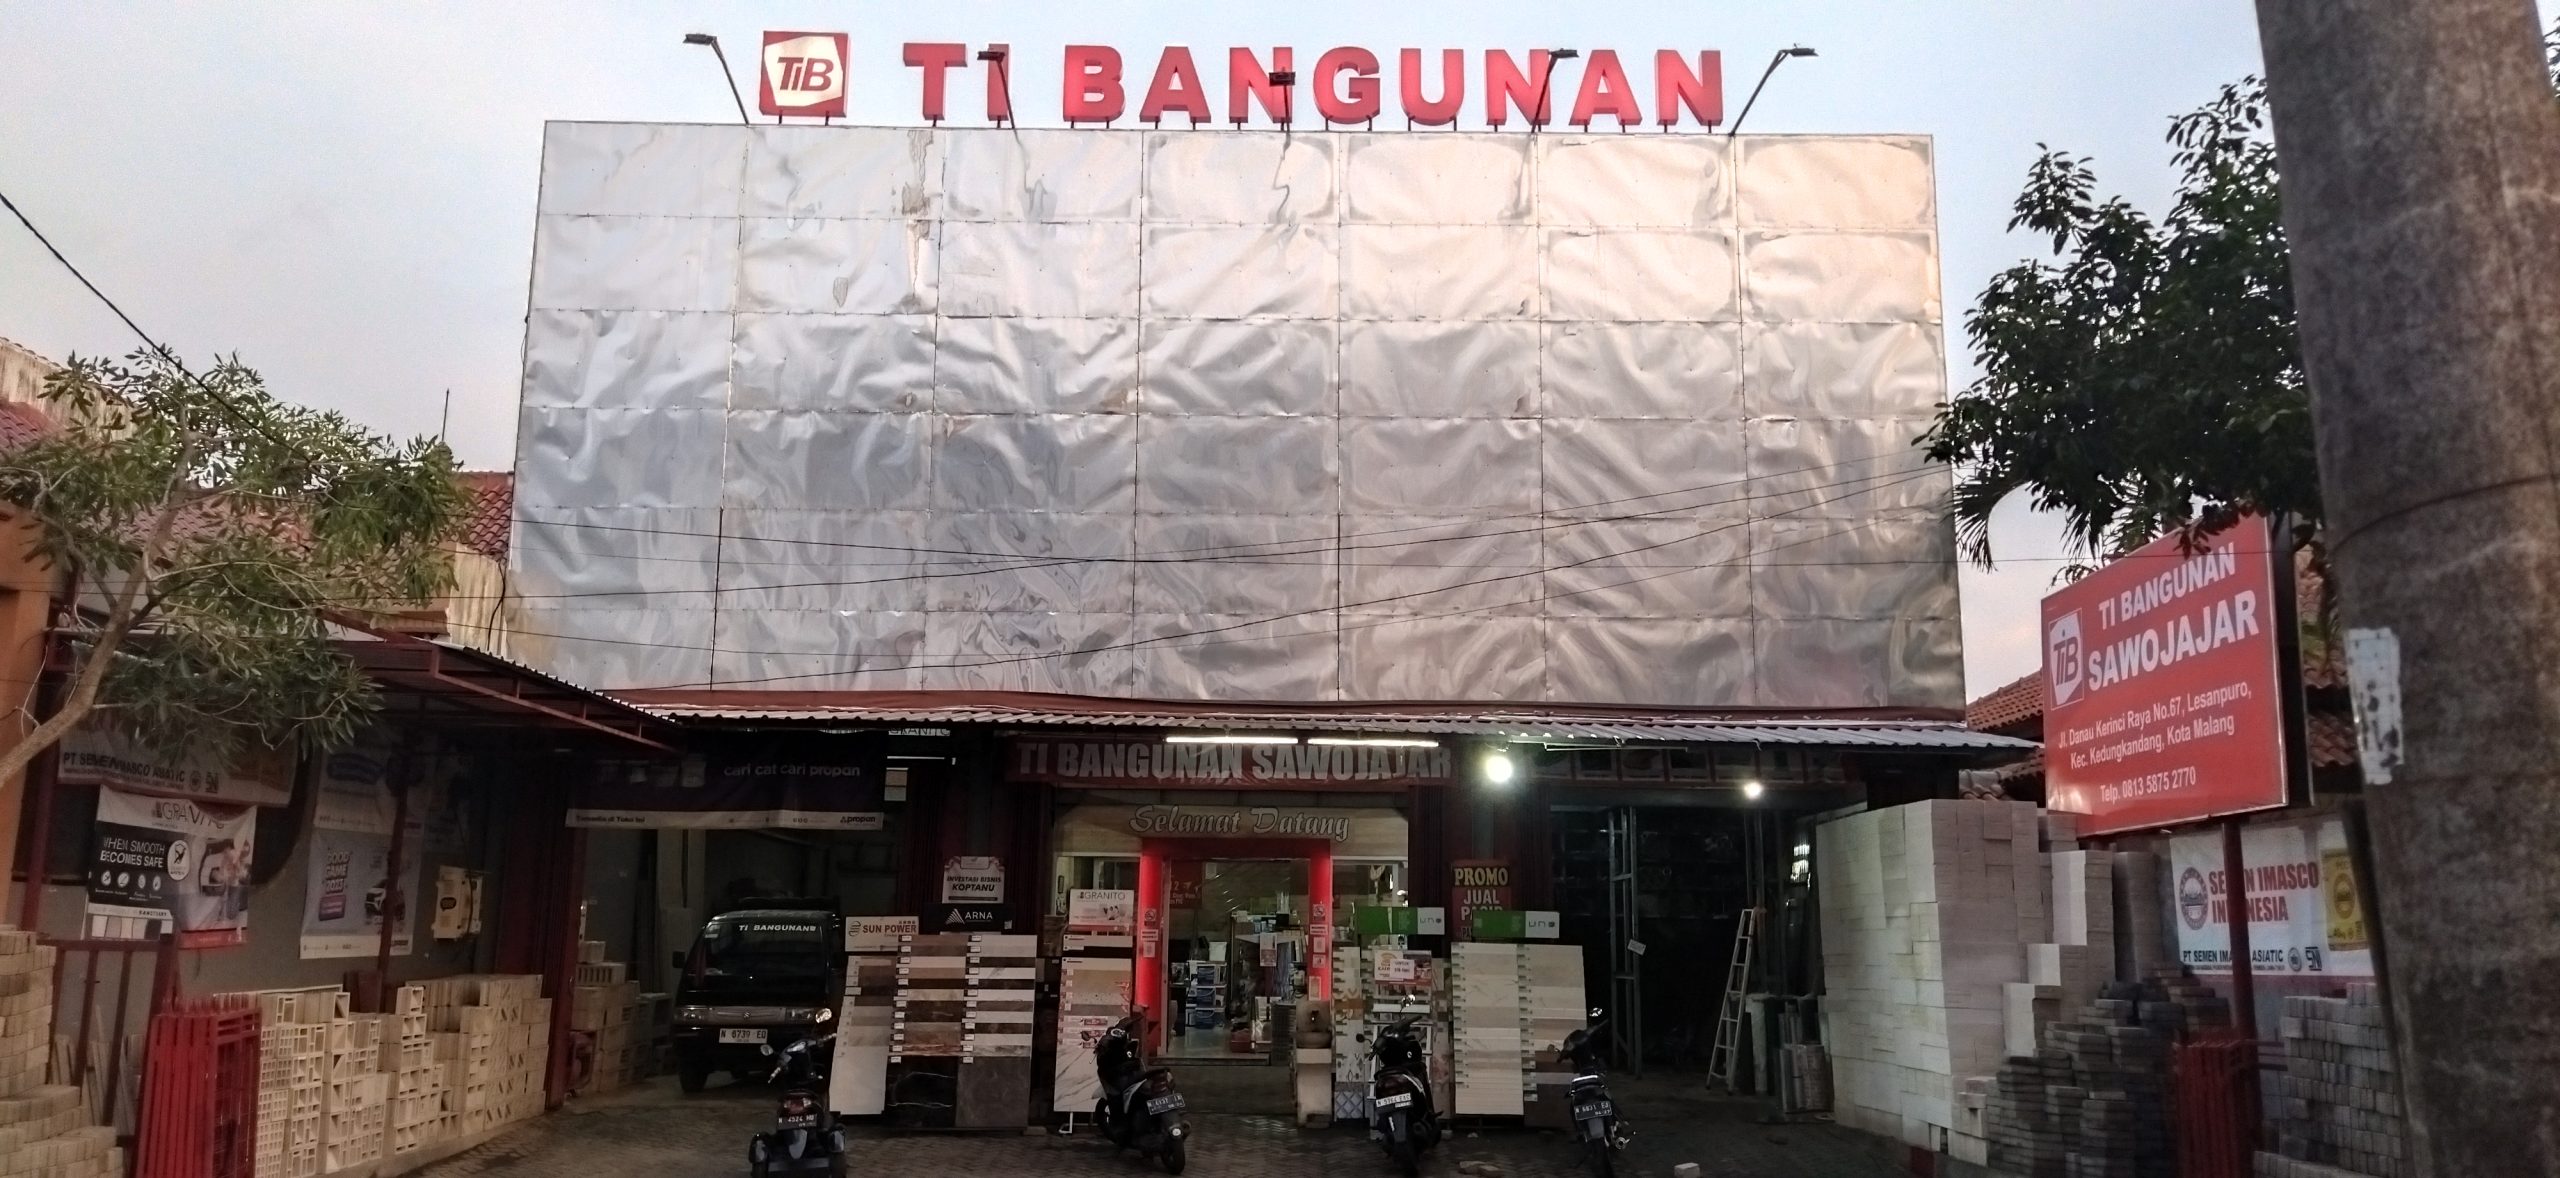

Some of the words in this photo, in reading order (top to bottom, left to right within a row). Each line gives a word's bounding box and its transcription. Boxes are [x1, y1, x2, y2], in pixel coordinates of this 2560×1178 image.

[903, 42, 1011, 121] TI
[1063, 44, 1724, 126] BANGUNAN
[2098, 597, 2116, 631] TI
[2119, 541, 2236, 623] BANGUNAN
[2088, 589, 2259, 692] SAWOJAJAR
[2069, 727, 2095, 746] Danau
[2096, 713, 2126, 739] Kerinci
[2127, 710, 2151, 731] Raya
[2153, 696, 2185, 722] No.67,
[2187, 681, 2252, 712] Lesanpuro,
[2070, 751, 2089, 770] Kec.
[2089, 734, 2165, 766] Kedungkandang,
[2167, 725, 2192, 746] Kota
[2193, 715, 2235, 739] Malang
[63, 752, 76, 766] PT
[1016, 743, 1049, 775] TI
[1057, 743, 1243, 779] BANGUNAN
[1252, 743, 1452, 781] SAWOJAJAR
[723, 763, 751, 777] cari
[755, 763, 778, 777] cat
[779, 762, 807, 776] cari
[809, 766, 861, 779] propan
[2099, 783, 2121, 805] Telp.
[2122, 777, 2144, 799] 0813
[2146, 771, 2170, 795] 5875
[2171, 765, 2197, 790] 2770
[1128, 804, 1242, 834] Selamat
[1249, 806, 1350, 842] Datang
[143, 855, 164, 869] SAFE
[1454, 867, 1509, 887] PROMO
[2208, 868, 2256, 895] SEN
[2257, 861, 2320, 892] IMASCO
[952, 883, 995, 892] KOPTANU
[1084, 890, 1126, 901] GRANITO
[1463, 888, 1501, 905] JUAL
[964, 911, 993, 920] ARNA
[2211, 895, 2289, 924] INNESIA
[863, 924, 882, 933] SUN
[884, 924, 917, 933] POWER
[2182, 950, 2191, 962] PT
[2193, 950, 2218, 962] SEMEN
[2252, 949, 2284, 962] ASIATIC
[720, 1030, 726, 1038] N
